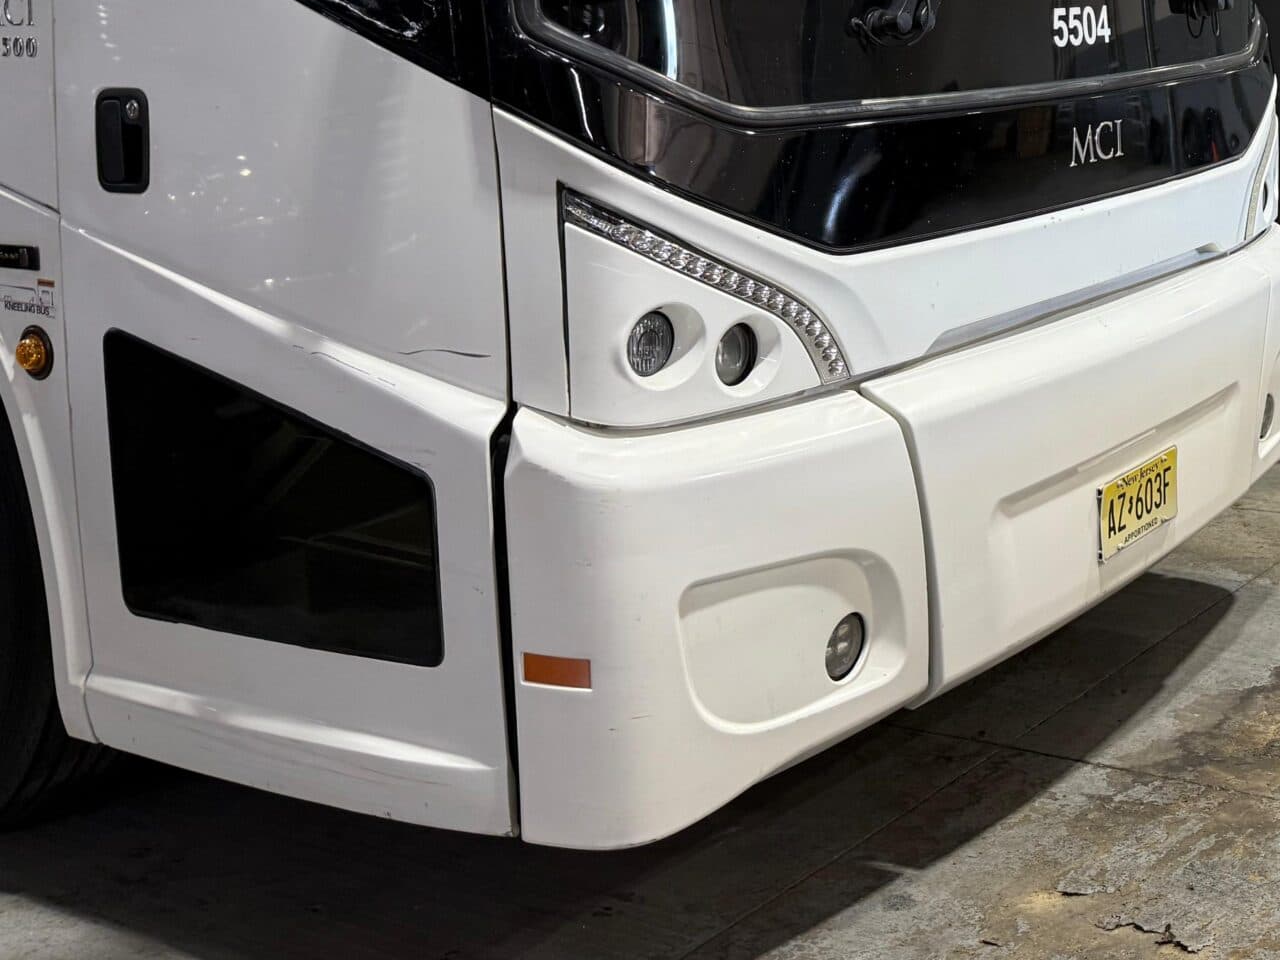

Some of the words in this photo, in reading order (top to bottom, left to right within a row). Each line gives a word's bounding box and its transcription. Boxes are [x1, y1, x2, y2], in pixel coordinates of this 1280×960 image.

[1053, 5, 1112, 48] 5504
[1069, 119, 1125, 168] MCI
[4, 300, 36, 314] KNEELING
[36, 305, 50, 316] BUS
